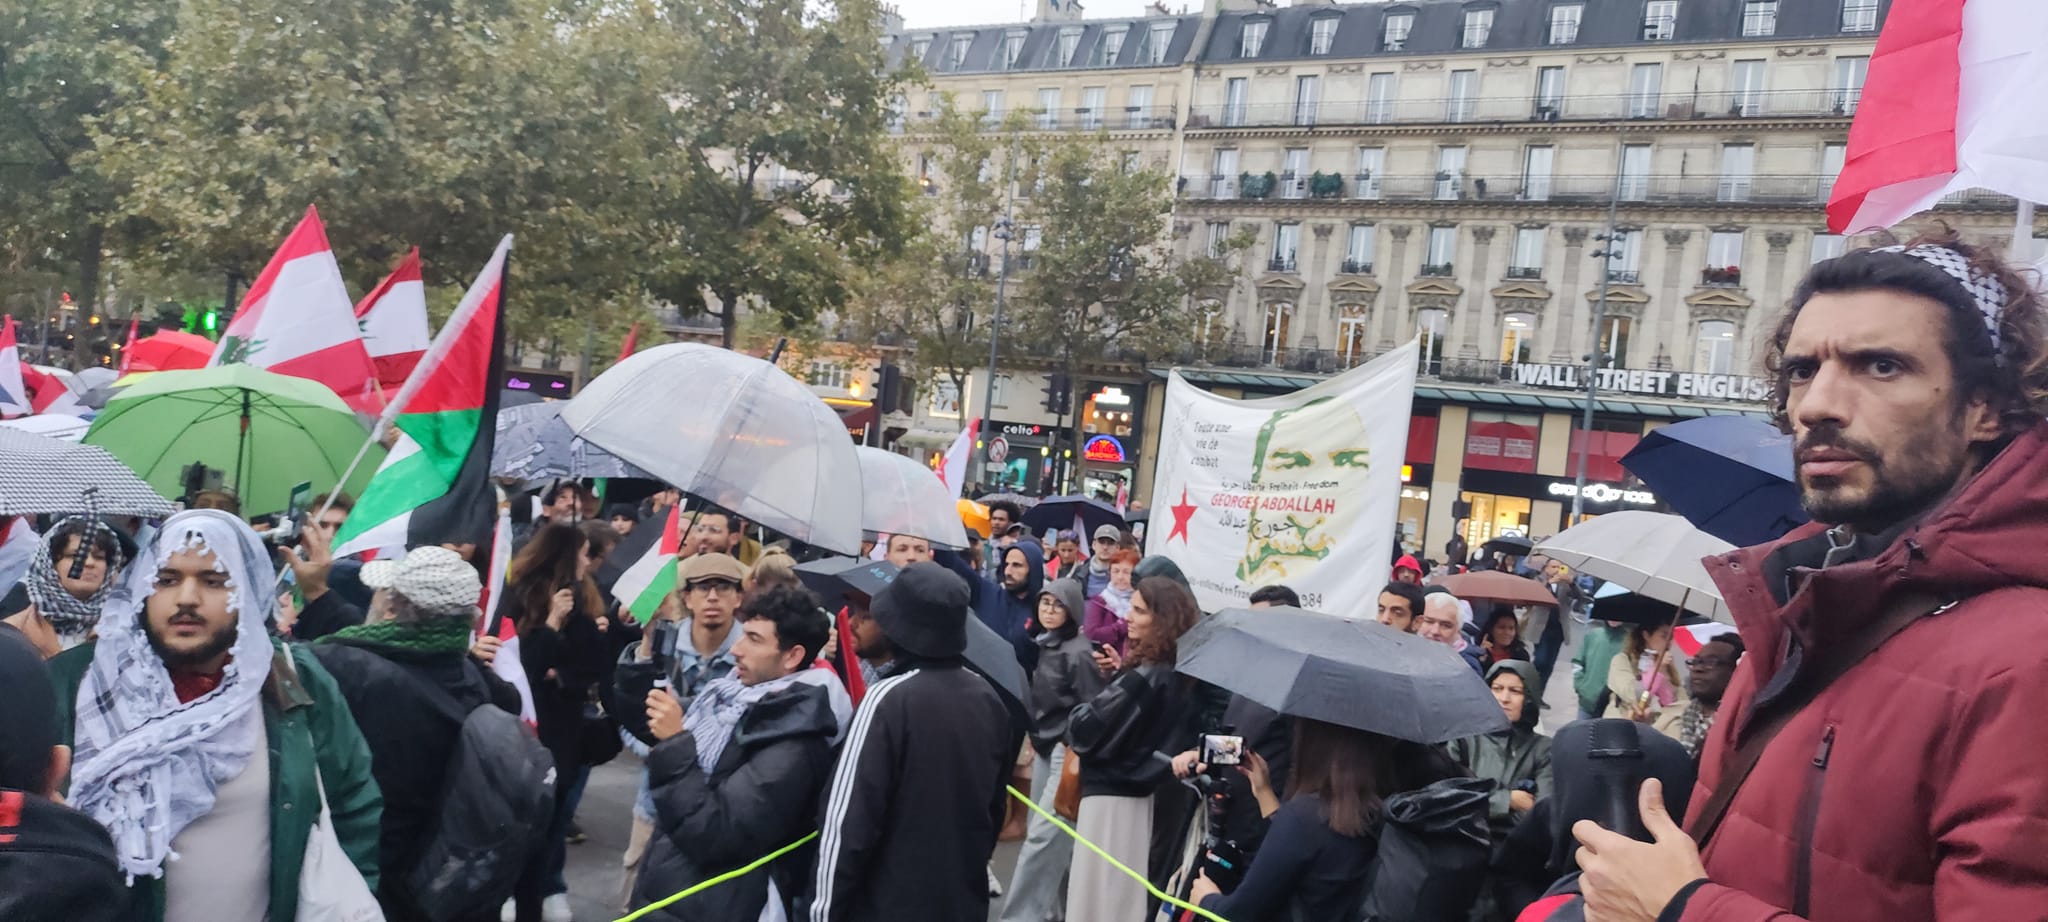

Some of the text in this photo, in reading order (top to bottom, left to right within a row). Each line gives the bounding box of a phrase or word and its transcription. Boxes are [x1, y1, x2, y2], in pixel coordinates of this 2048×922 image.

[1518, 363, 1577, 388] WALL
[1586, 366, 1672, 394] STREET
[1196, 436, 1219, 451] vie de
[1190, 456, 1219, 469] combat
[1303, 480, 1339, 490] Freedom
[1211, 493, 1335, 514] GEORGES ABDALLAH
[1301, 592, 1322, 608] 984
